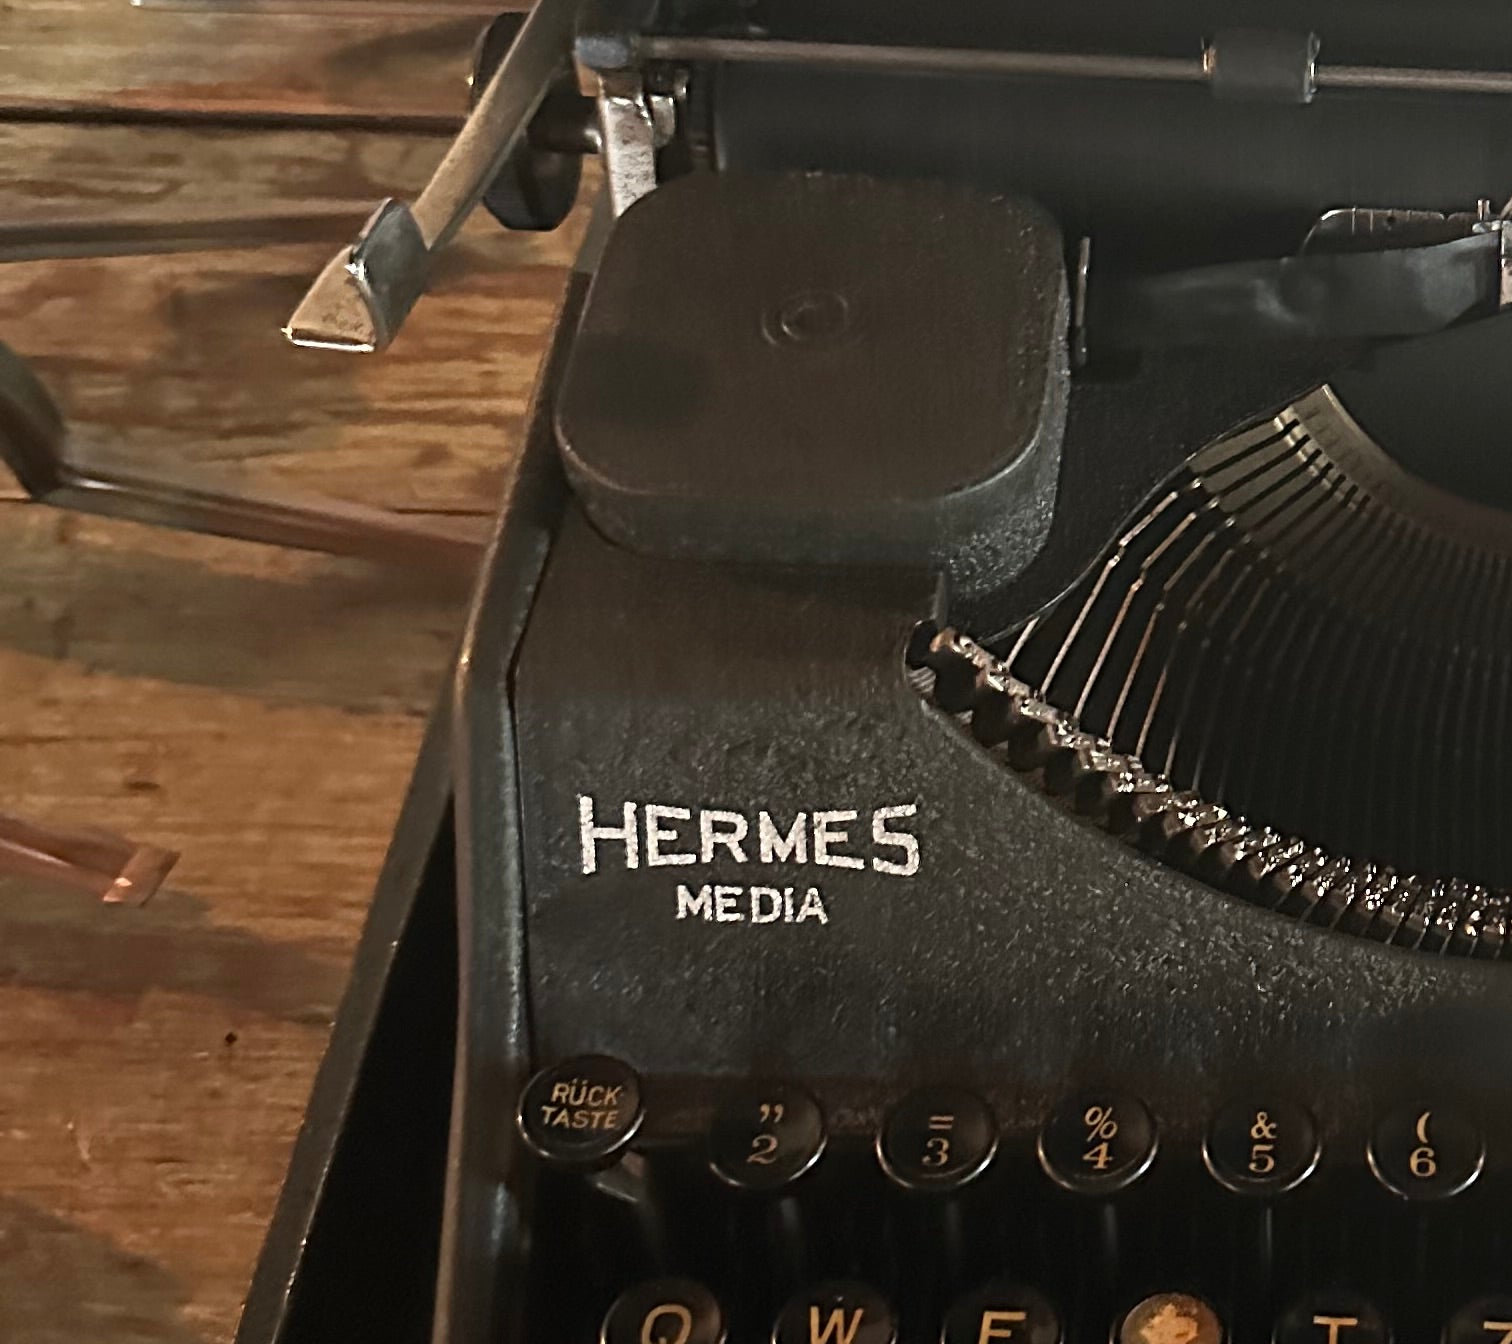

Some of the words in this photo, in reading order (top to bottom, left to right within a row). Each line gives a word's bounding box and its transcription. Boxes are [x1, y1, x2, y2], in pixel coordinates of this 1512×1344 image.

[577, 794, 919, 875] HERMES
[677, 885, 828, 924] MEDIA
[542, 1104, 619, 1130] TASTE
[1085, 1107, 1117, 1141] %
[1251, 1112, 1276, 1138] &
[1416, 1112, 1430, 1144] (
[748, 1135, 777, 1163] 2
[923, 1139, 948, 1165] 3
[1084, 1143, 1111, 1168] 4
[1249, 1145, 1274, 1171] 5
[1409, 1149, 1436, 1177] 6
